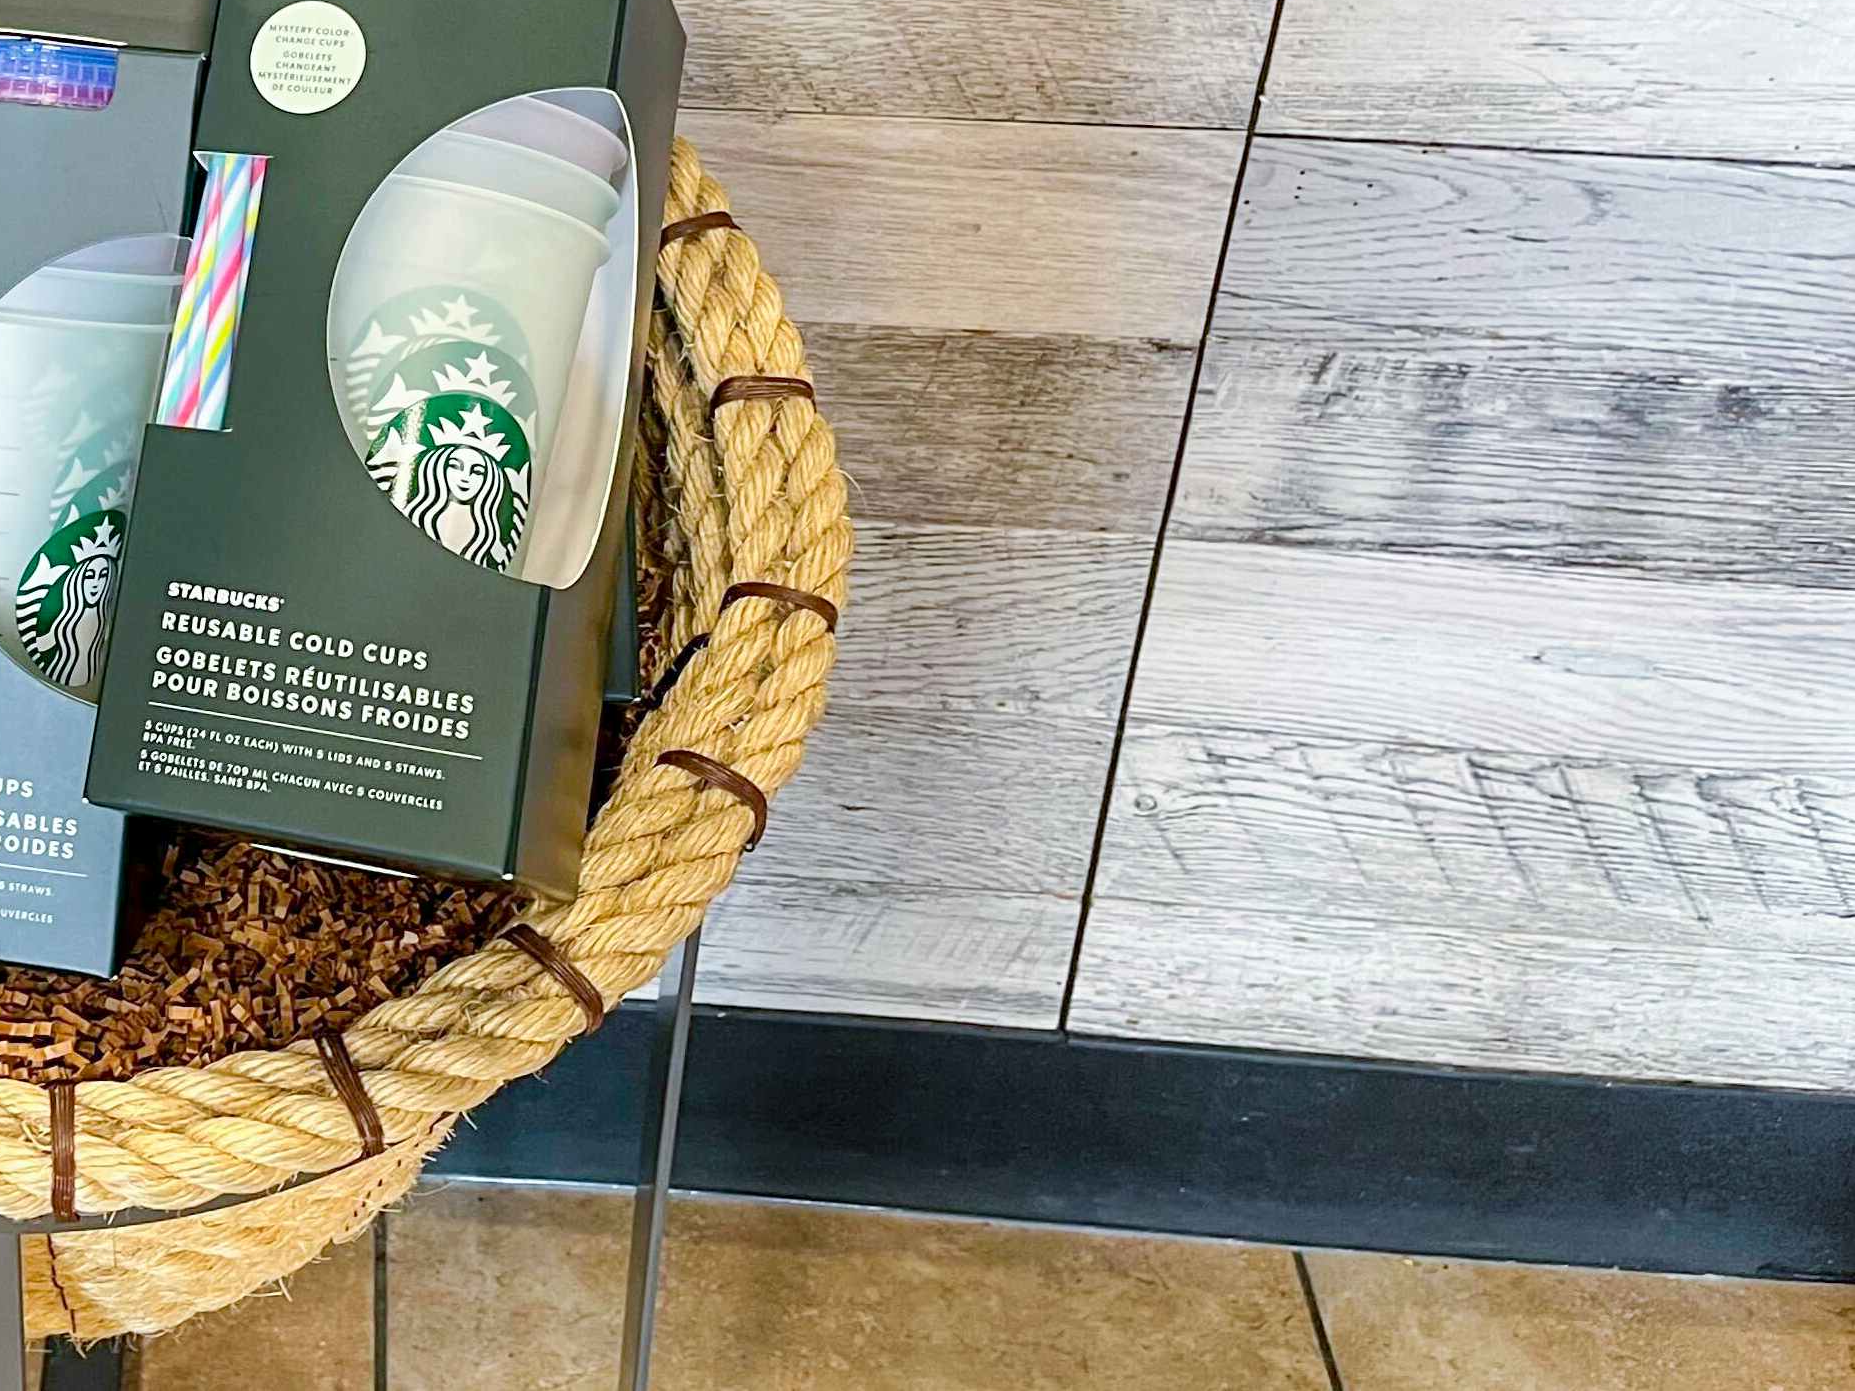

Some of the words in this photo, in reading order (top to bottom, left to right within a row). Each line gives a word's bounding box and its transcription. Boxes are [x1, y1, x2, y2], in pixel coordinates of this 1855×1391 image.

[270, 24, 313, 34] MYSTERY
[275, 35, 316, 46] CHANGE
[319, 38, 345, 48] CUPS
[275, 61, 336, 72] CHANGEANT
[287, 84, 333, 94] COULEUR
[167, 581, 281, 613] STARBUCKS
[161, 611, 282, 647] REUSABLE
[289, 631, 355, 659] COLD
[362, 643, 429, 672] CUPS
[155, 645, 277, 682] GOBELETS
[284, 665, 475, 716] RÉUTILISABLES
[151, 670, 218, 698] POUR
[226, 681, 353, 721] BOISSONS
[361, 703, 470, 740] FROIDES
[143, 731, 164, 744] BPA
[155, 721, 184, 736] CUPS
[186, 727, 206, 739] (24
[209, 730, 221, 742] FL
[225, 733, 241, 745] OZ
[243, 736, 278, 753] EACH)
[282, 742, 313, 757] WITH
[327, 751, 353, 764] LIDS
[356, 756, 381, 769] AND
[395, 762, 446, 780] STRAWS.
[138, 760, 151, 772] ET
[213, 774, 243, 788] SANS
[246, 779, 272, 793] BPA.
[150, 750, 206, 769] GOBELETS
[208, 760, 223, 772] DE
[252, 768, 268, 781] ML
[271, 771, 321, 790] CHACUN
[323, 780, 354, 795] AVEC
[367, 789, 443, 811] COUVERCLES
